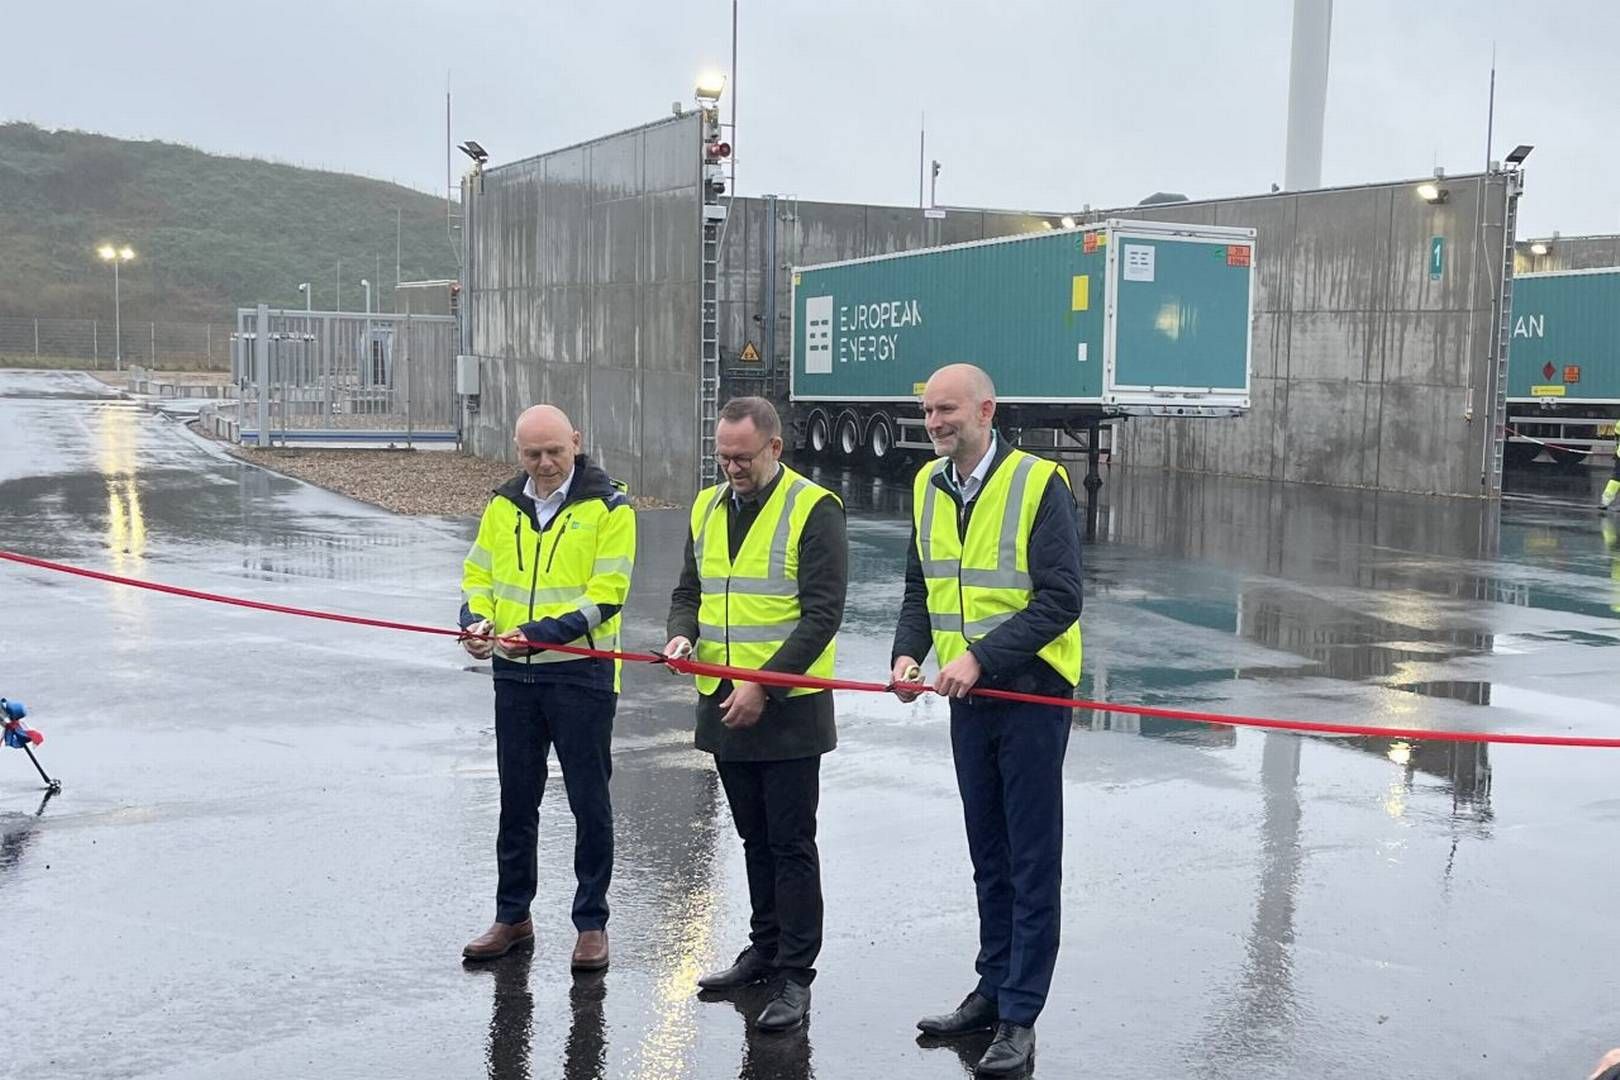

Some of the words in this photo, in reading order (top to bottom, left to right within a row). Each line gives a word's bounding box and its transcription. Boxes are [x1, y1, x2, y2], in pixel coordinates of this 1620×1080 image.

[1434, 244, 1441, 267] 1
[840, 300, 922, 331] EUROPEAN
[840, 333, 898, 362] ENERGY
